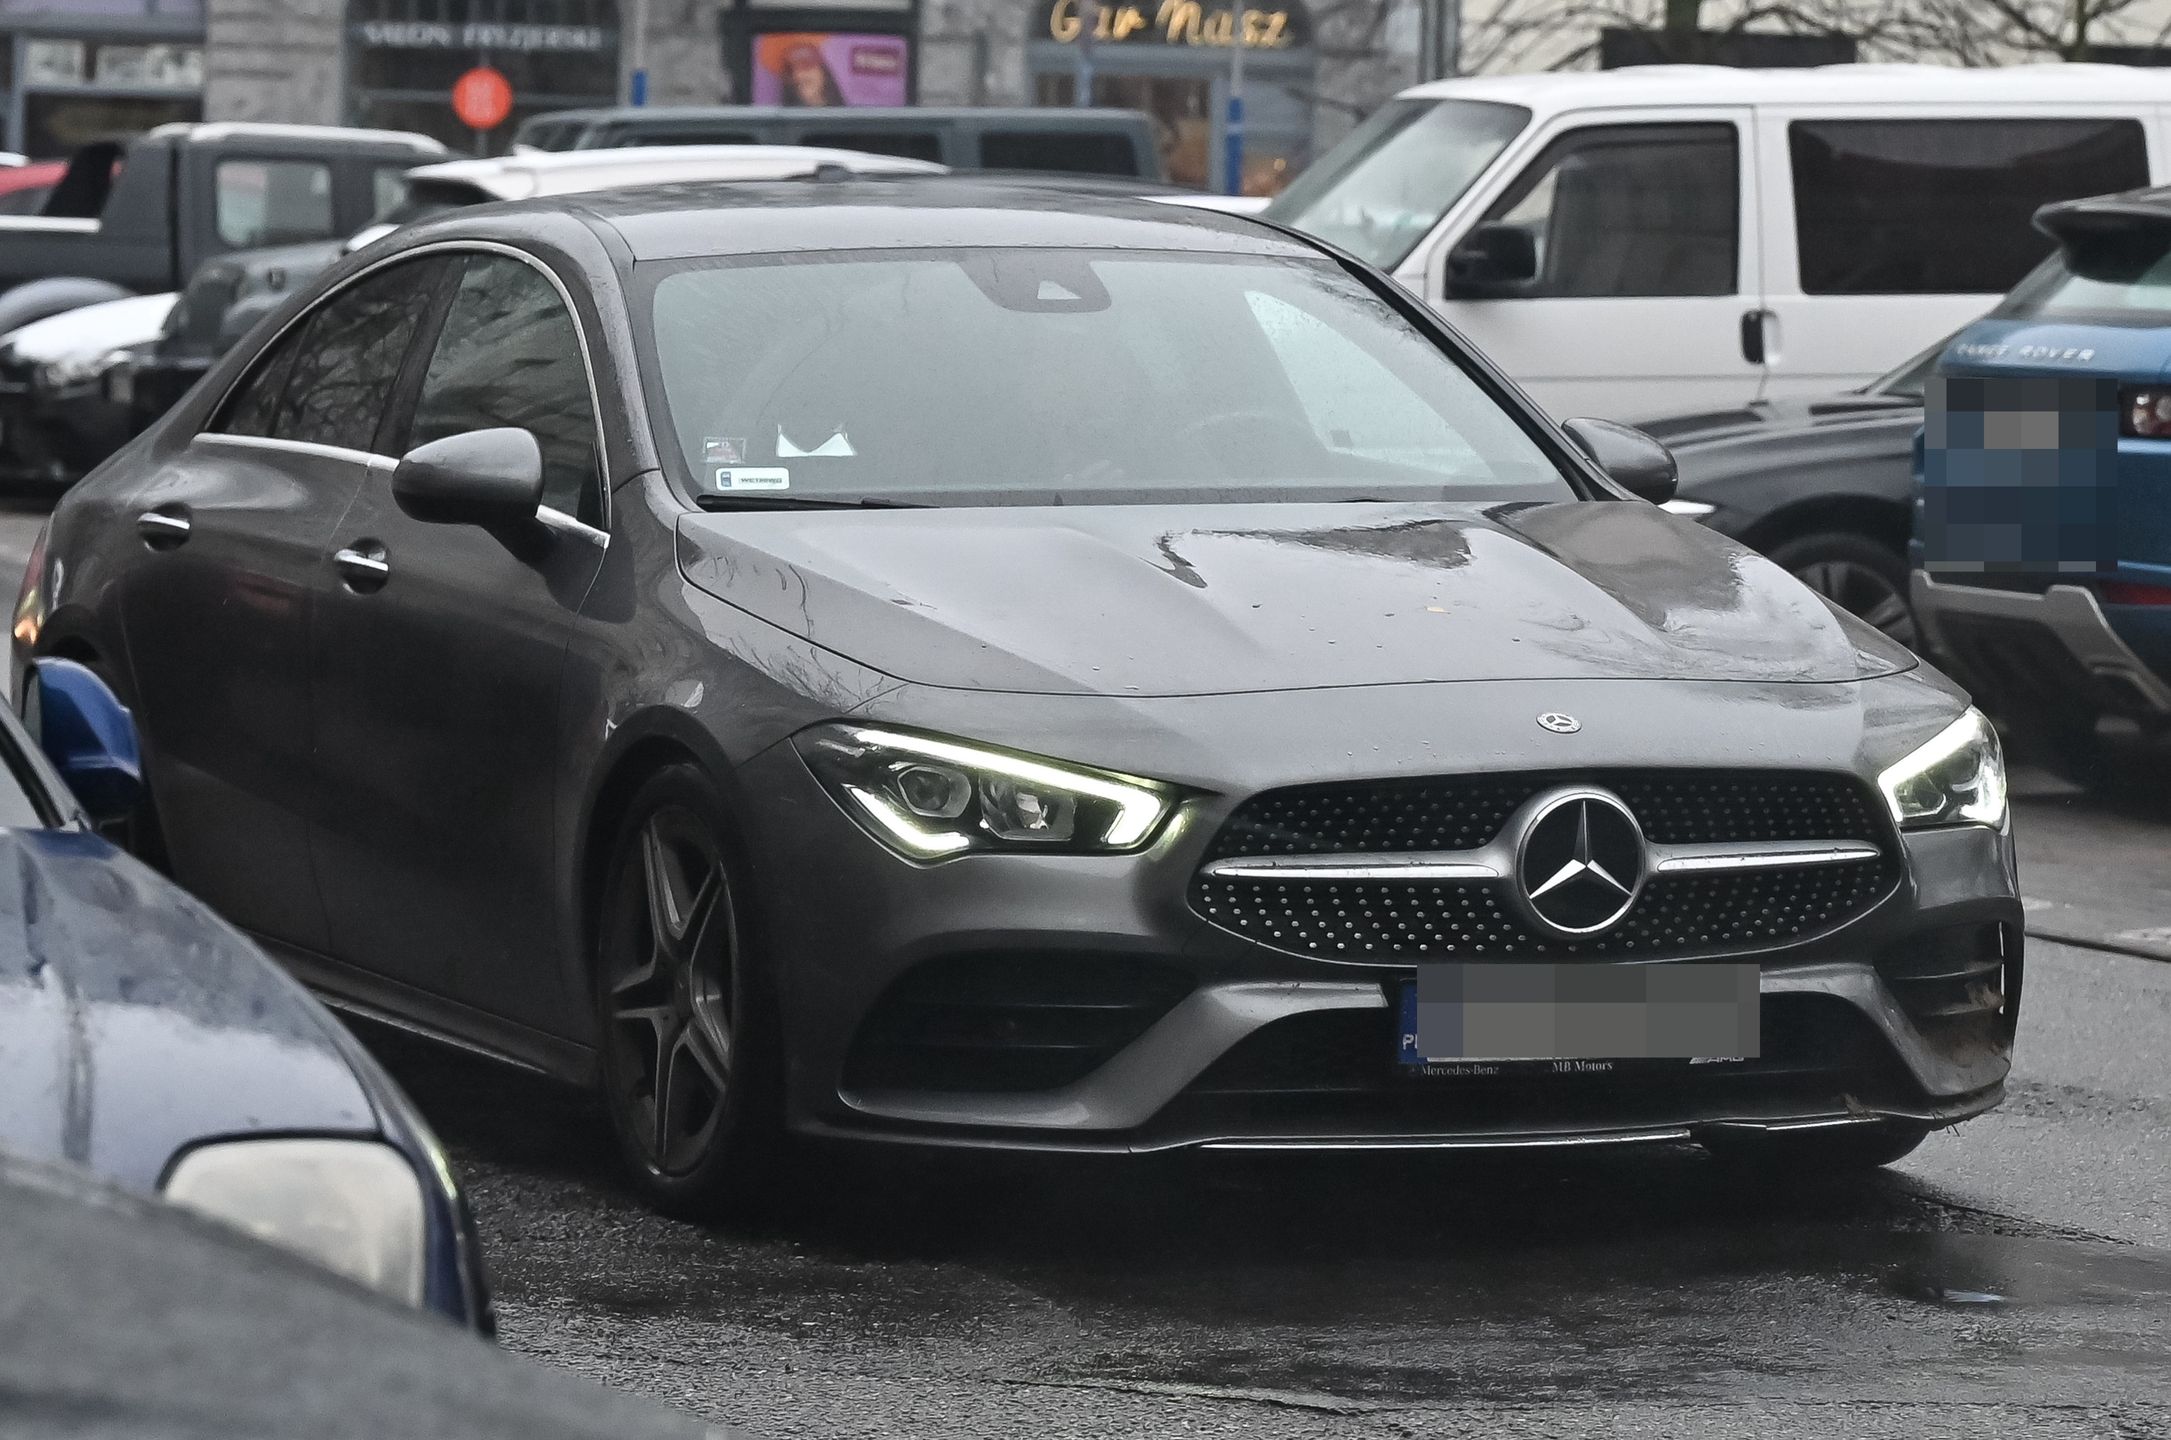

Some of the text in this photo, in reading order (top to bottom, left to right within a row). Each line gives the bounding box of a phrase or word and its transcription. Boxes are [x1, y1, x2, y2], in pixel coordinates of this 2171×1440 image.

[1421, 1064, 1499, 1076] Mercedes-Benz
[1552, 1060, 1613, 1073] MB Motors
